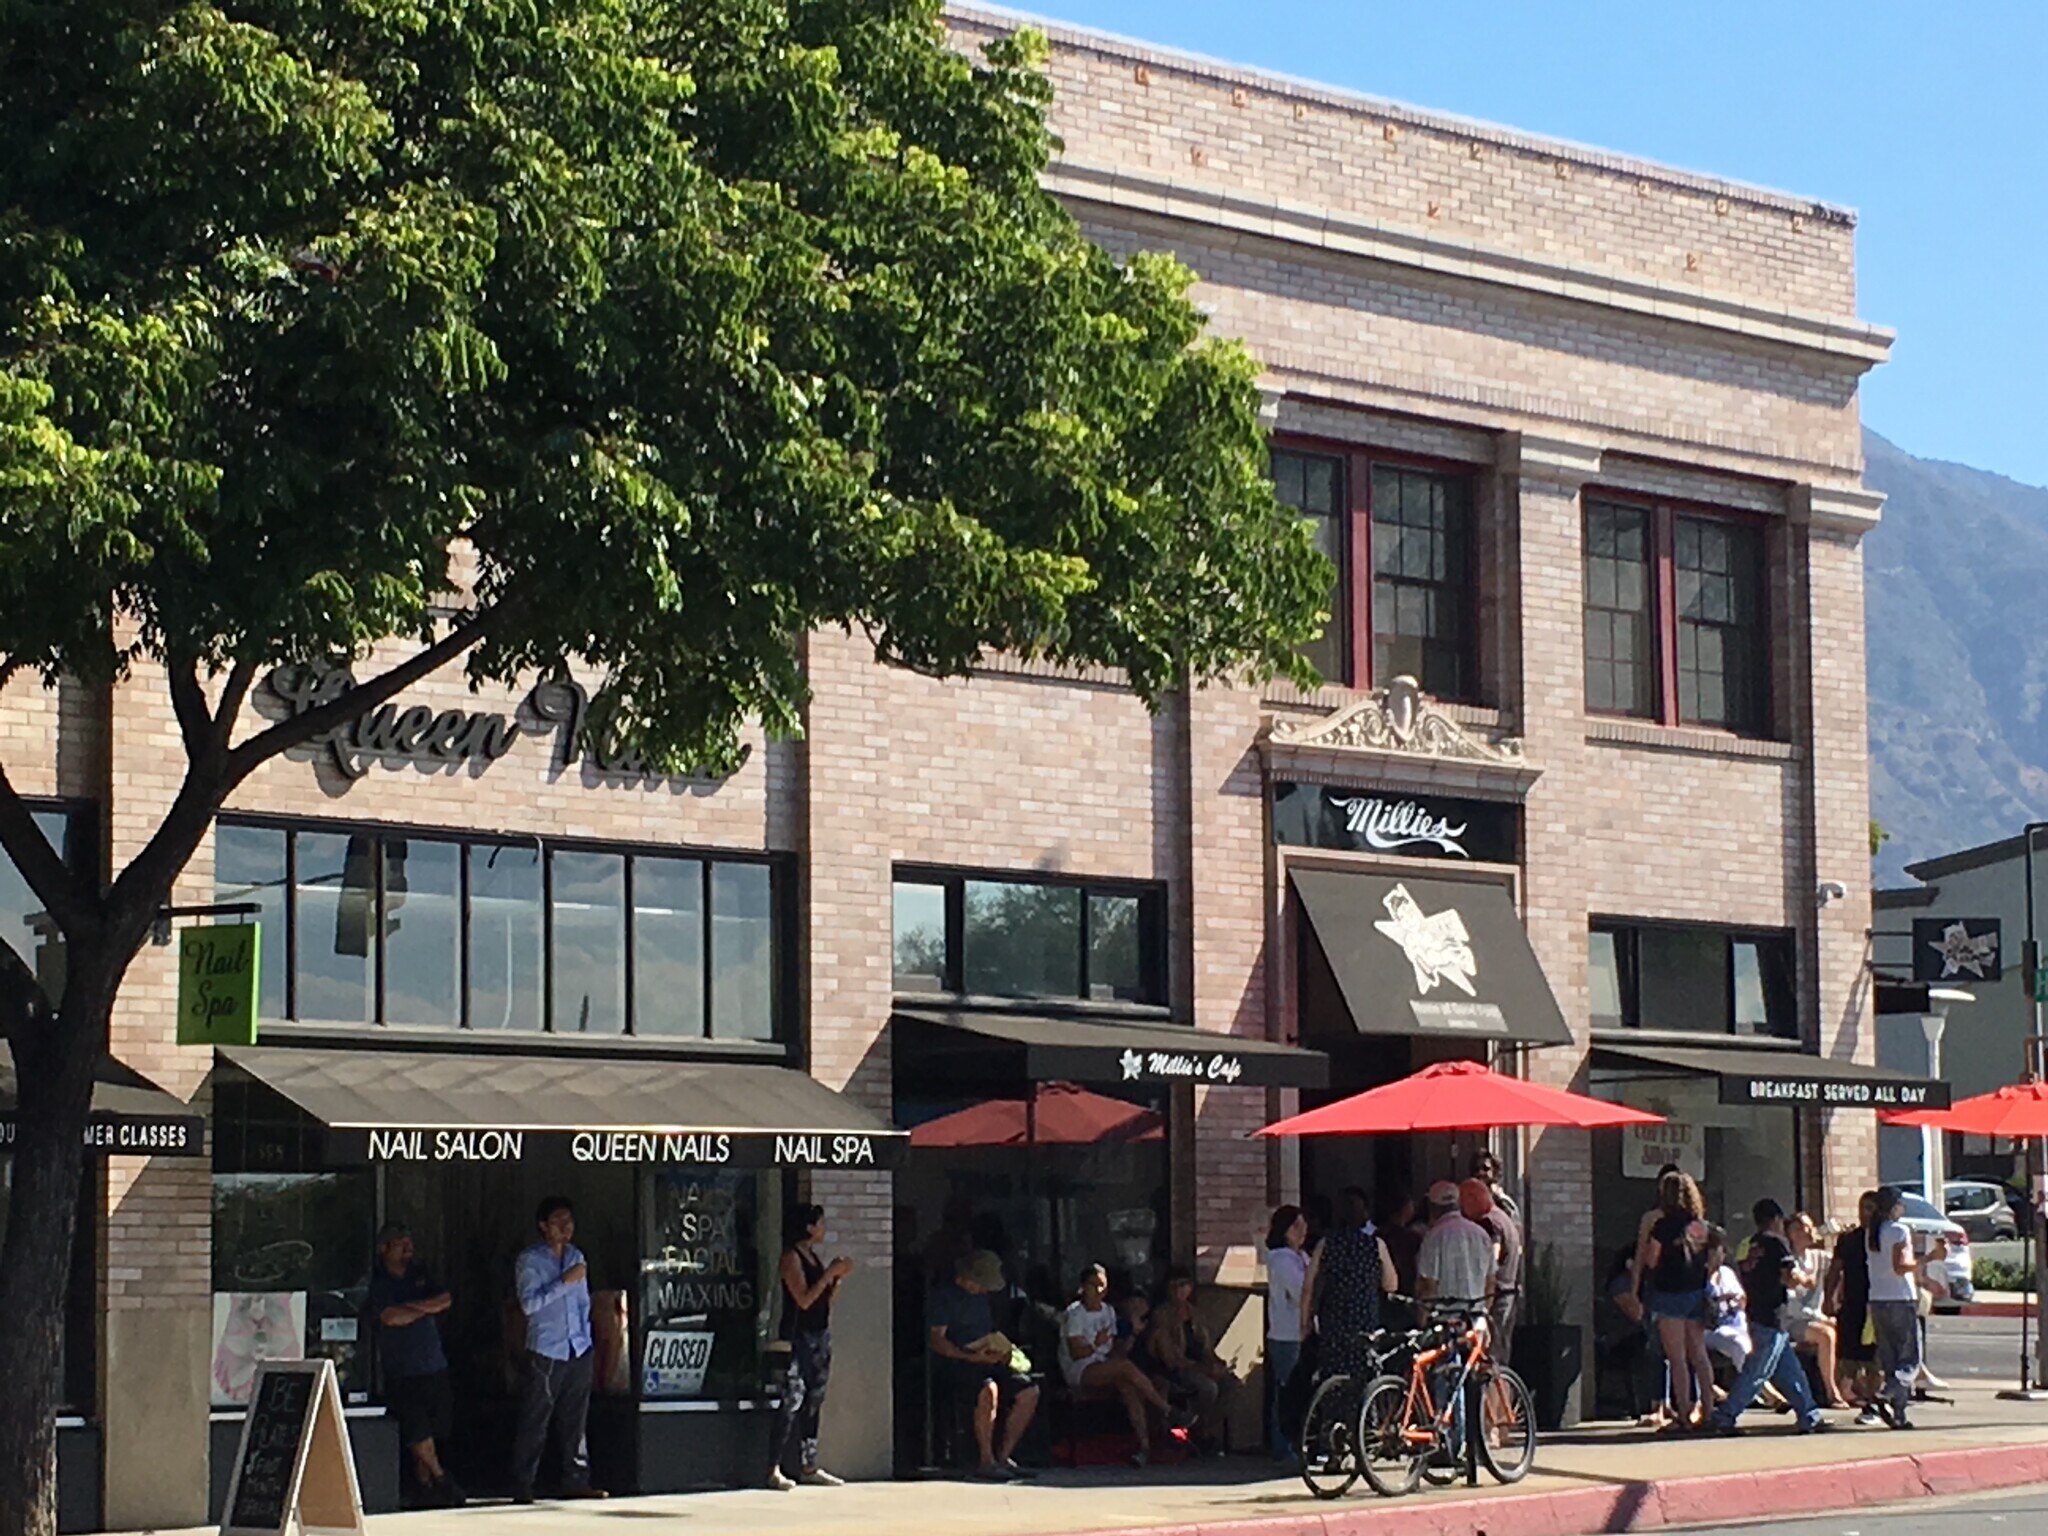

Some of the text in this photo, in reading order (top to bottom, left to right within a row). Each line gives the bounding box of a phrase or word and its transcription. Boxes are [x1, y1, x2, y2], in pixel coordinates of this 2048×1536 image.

[185, 939, 249, 975] Nail
[191, 980, 238, 1029] Spa
[1750, 1080, 1926, 1103] BREAKFAST SERVED ALL DAY
[119, 1124, 187, 1147] CLASSES
[368, 1131, 874, 1165] NAIL SALON QUEEN NAILS NAIL SPA
[682, 1213, 727, 1242] SPA
[662, 1245, 742, 1276] FACIAL
[659, 1281, 752, 1310] WAXING
[648, 1337, 708, 1370] CLOSED
